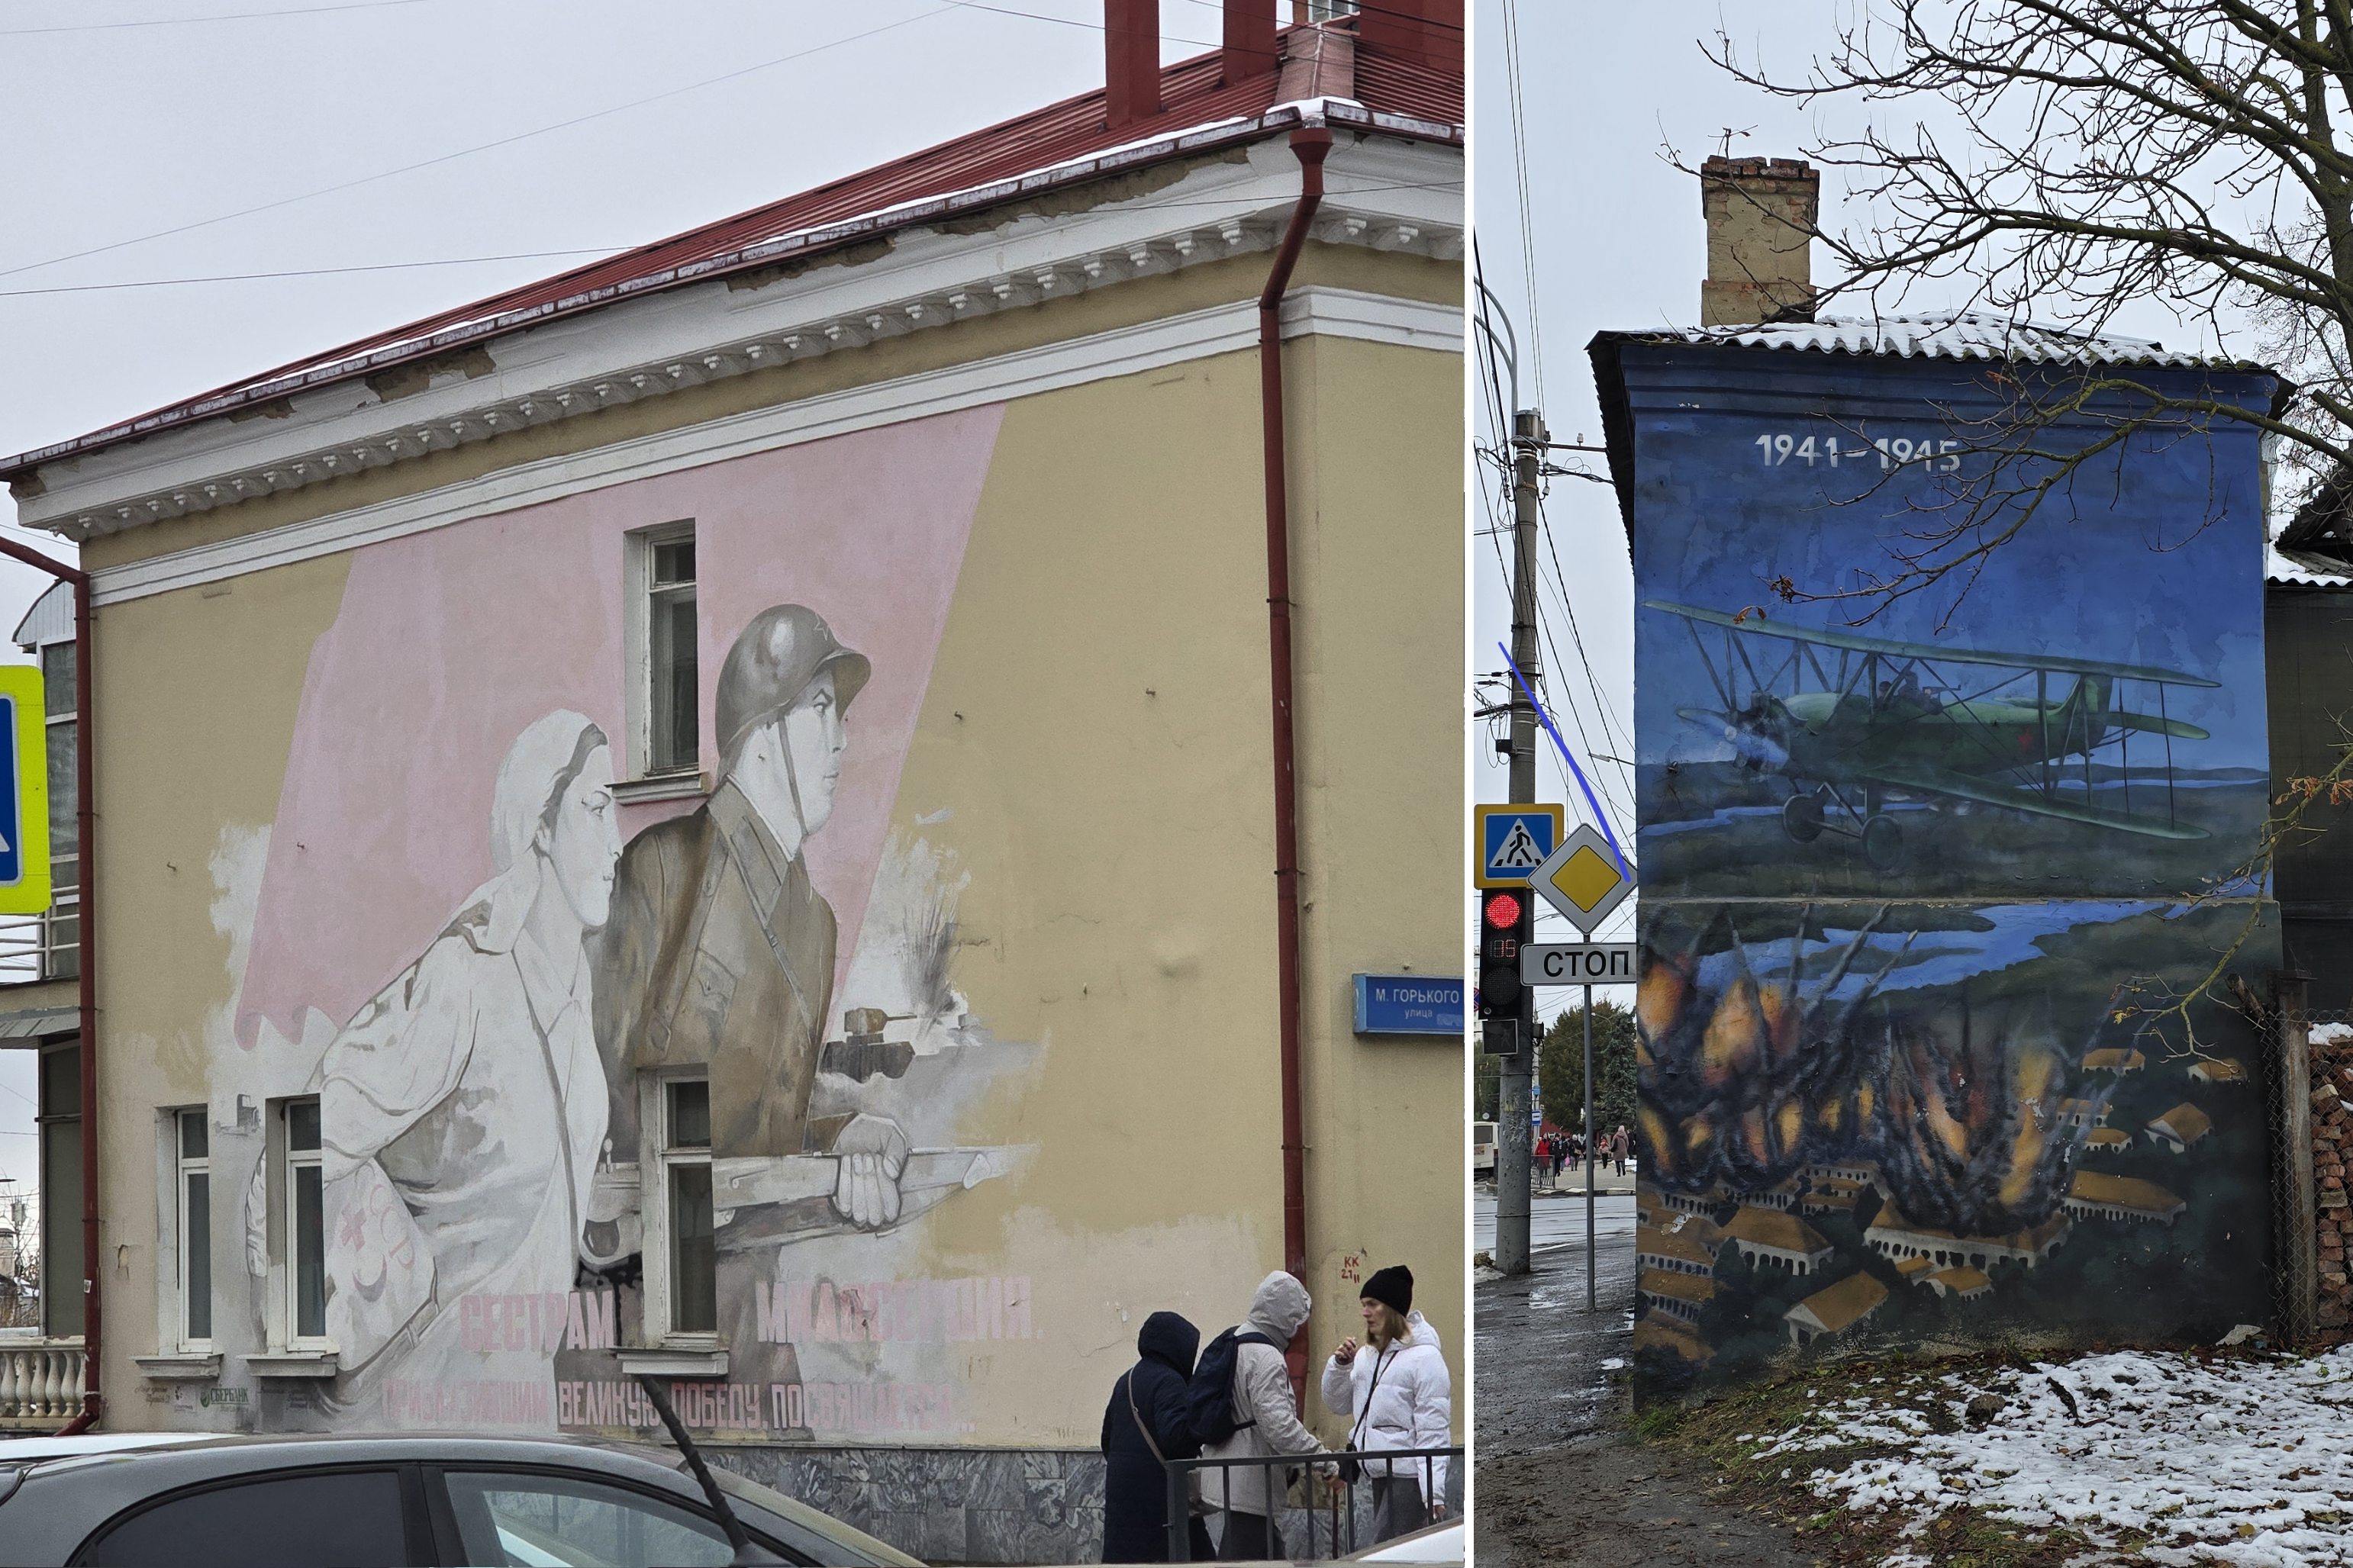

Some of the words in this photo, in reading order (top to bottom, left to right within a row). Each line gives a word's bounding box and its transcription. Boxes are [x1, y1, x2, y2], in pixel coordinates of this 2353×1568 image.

[1543, 951, 1629, 977] СТОП
[1375, 988, 1389, 1002] М.
[1393, 989, 1459, 1004] ГОРЬКОГО
[1404, 1009, 1433, 1019] улица
[460, 1289, 614, 1351] СЕСТРАМ
[211, 1387, 249, 1402] СБЕРБАНК
[559, 1381, 661, 1427] ВЕЛИКУЮ
